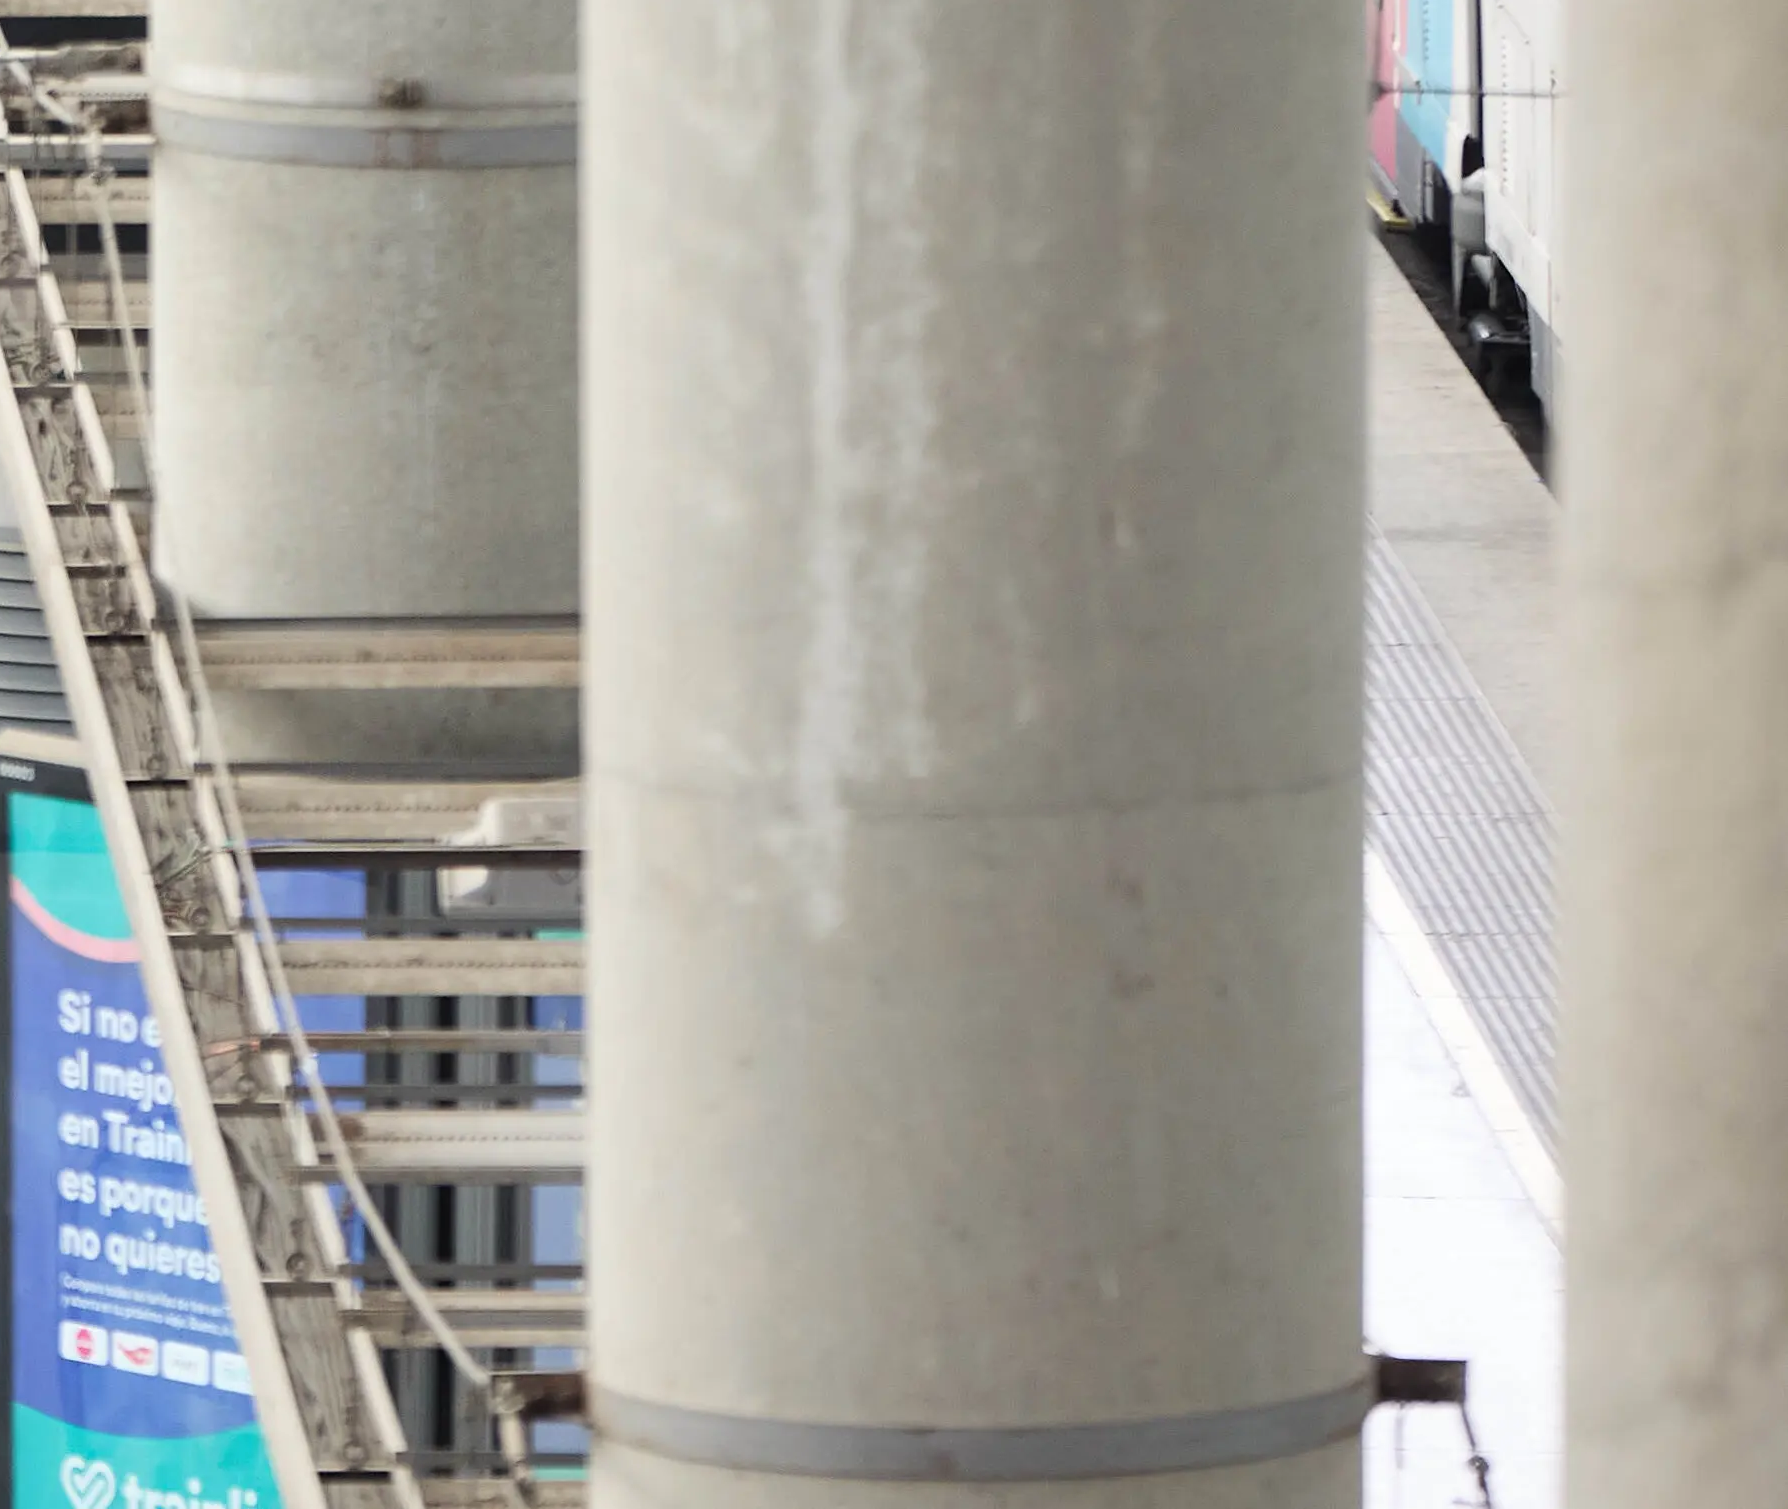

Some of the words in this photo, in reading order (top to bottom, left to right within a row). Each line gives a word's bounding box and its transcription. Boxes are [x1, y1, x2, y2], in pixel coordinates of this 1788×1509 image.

[57, 988, 92, 1035] Si
[95, 1006, 138, 1043] no
[140, 1014, 164, 1048] e
[57, 1047, 90, 1092] el
[93, 1057, 177, 1112] mejo
[57, 1112, 100, 1149] en
[57, 1168, 97, 1204] es
[59, 1223, 101, 1260] no
[105, 1226, 222, 1285] quieres
